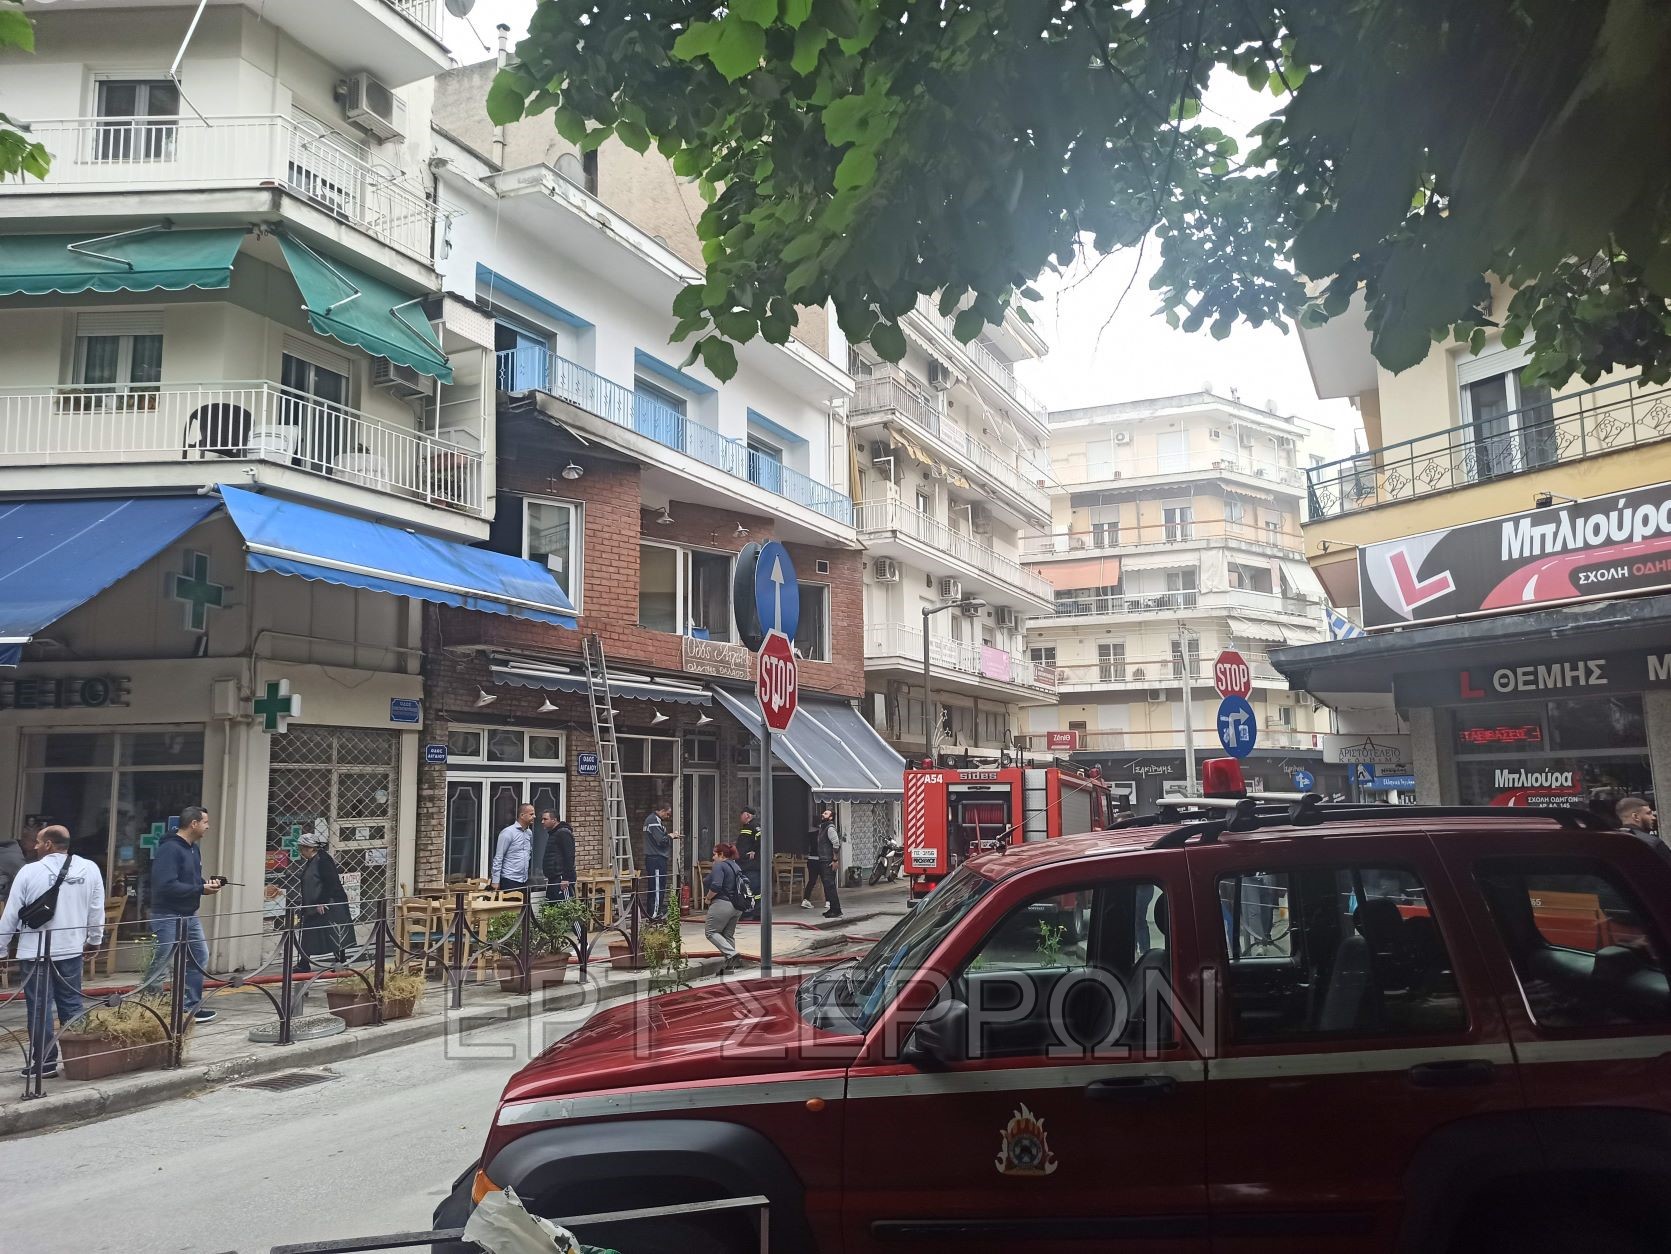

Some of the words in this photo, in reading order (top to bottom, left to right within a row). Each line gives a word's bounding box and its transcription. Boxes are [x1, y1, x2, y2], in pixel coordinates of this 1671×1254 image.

[1578, 566, 1629, 585] ΣΧΟΛΗ
[761, 654, 796, 709] STOP
[1216, 663, 1248, 692] STOP
[1492, 659, 1608, 693] ΘΕΜΗΣ
[923, 774, 943, 783] A54
[960, 772, 997, 780] sides
[1494, 767, 1573, 788] Μπλιούρα
